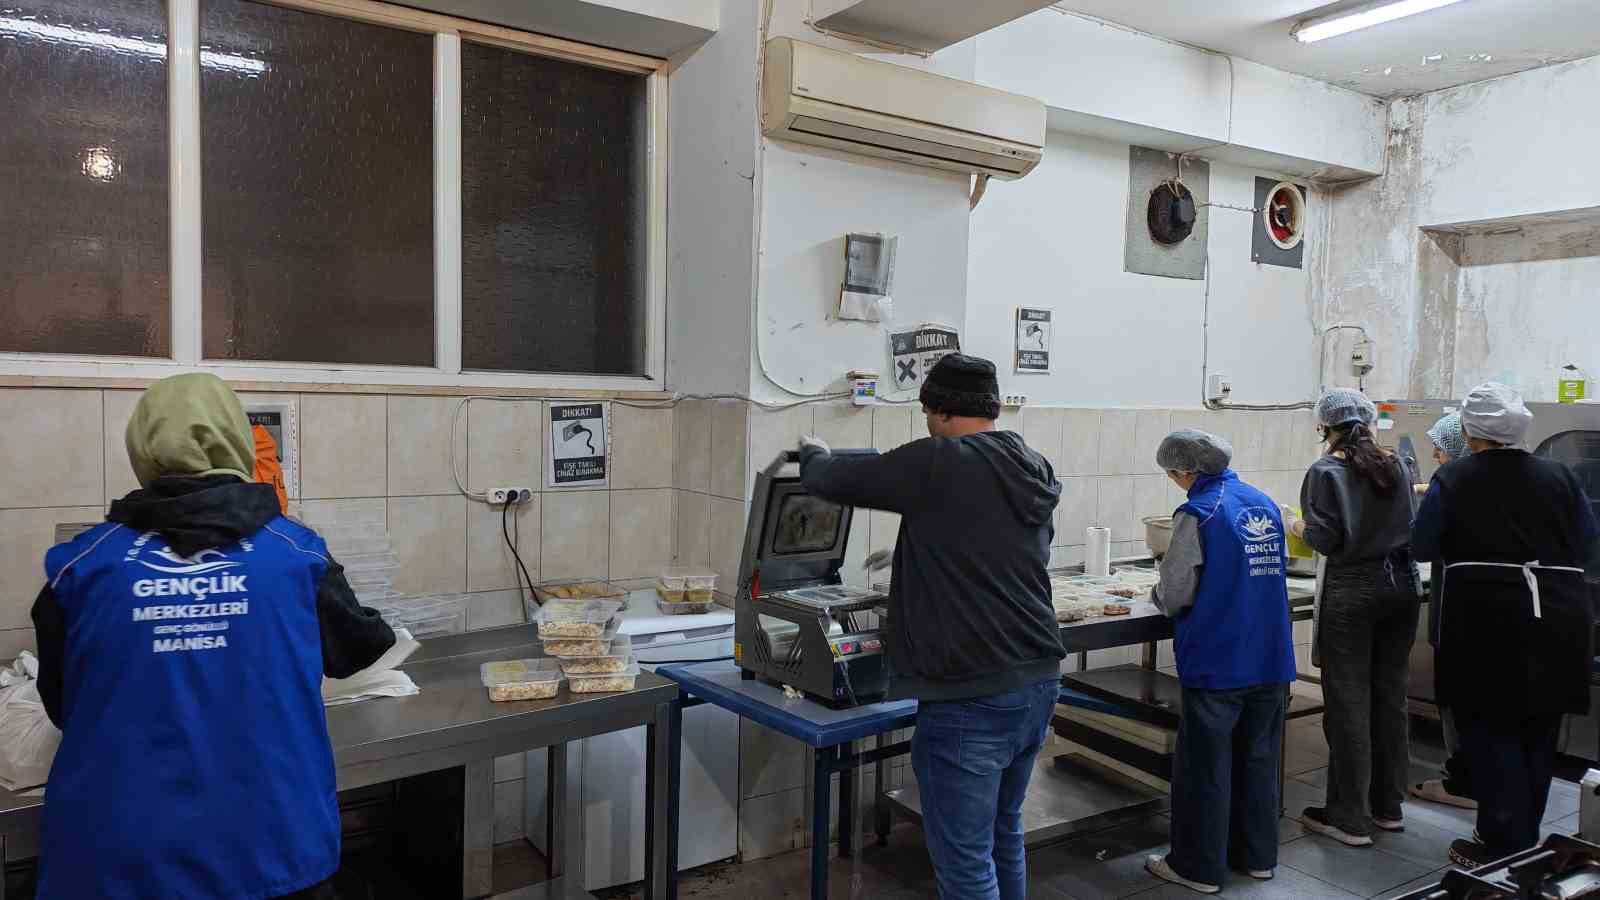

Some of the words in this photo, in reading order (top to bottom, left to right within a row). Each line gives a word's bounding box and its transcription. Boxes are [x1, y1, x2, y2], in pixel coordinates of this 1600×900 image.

[132, 571, 248, 600] GENÇLİK
[132, 599, 248, 621] MERKEZLERİ
[153, 634, 227, 652] MANİSA
